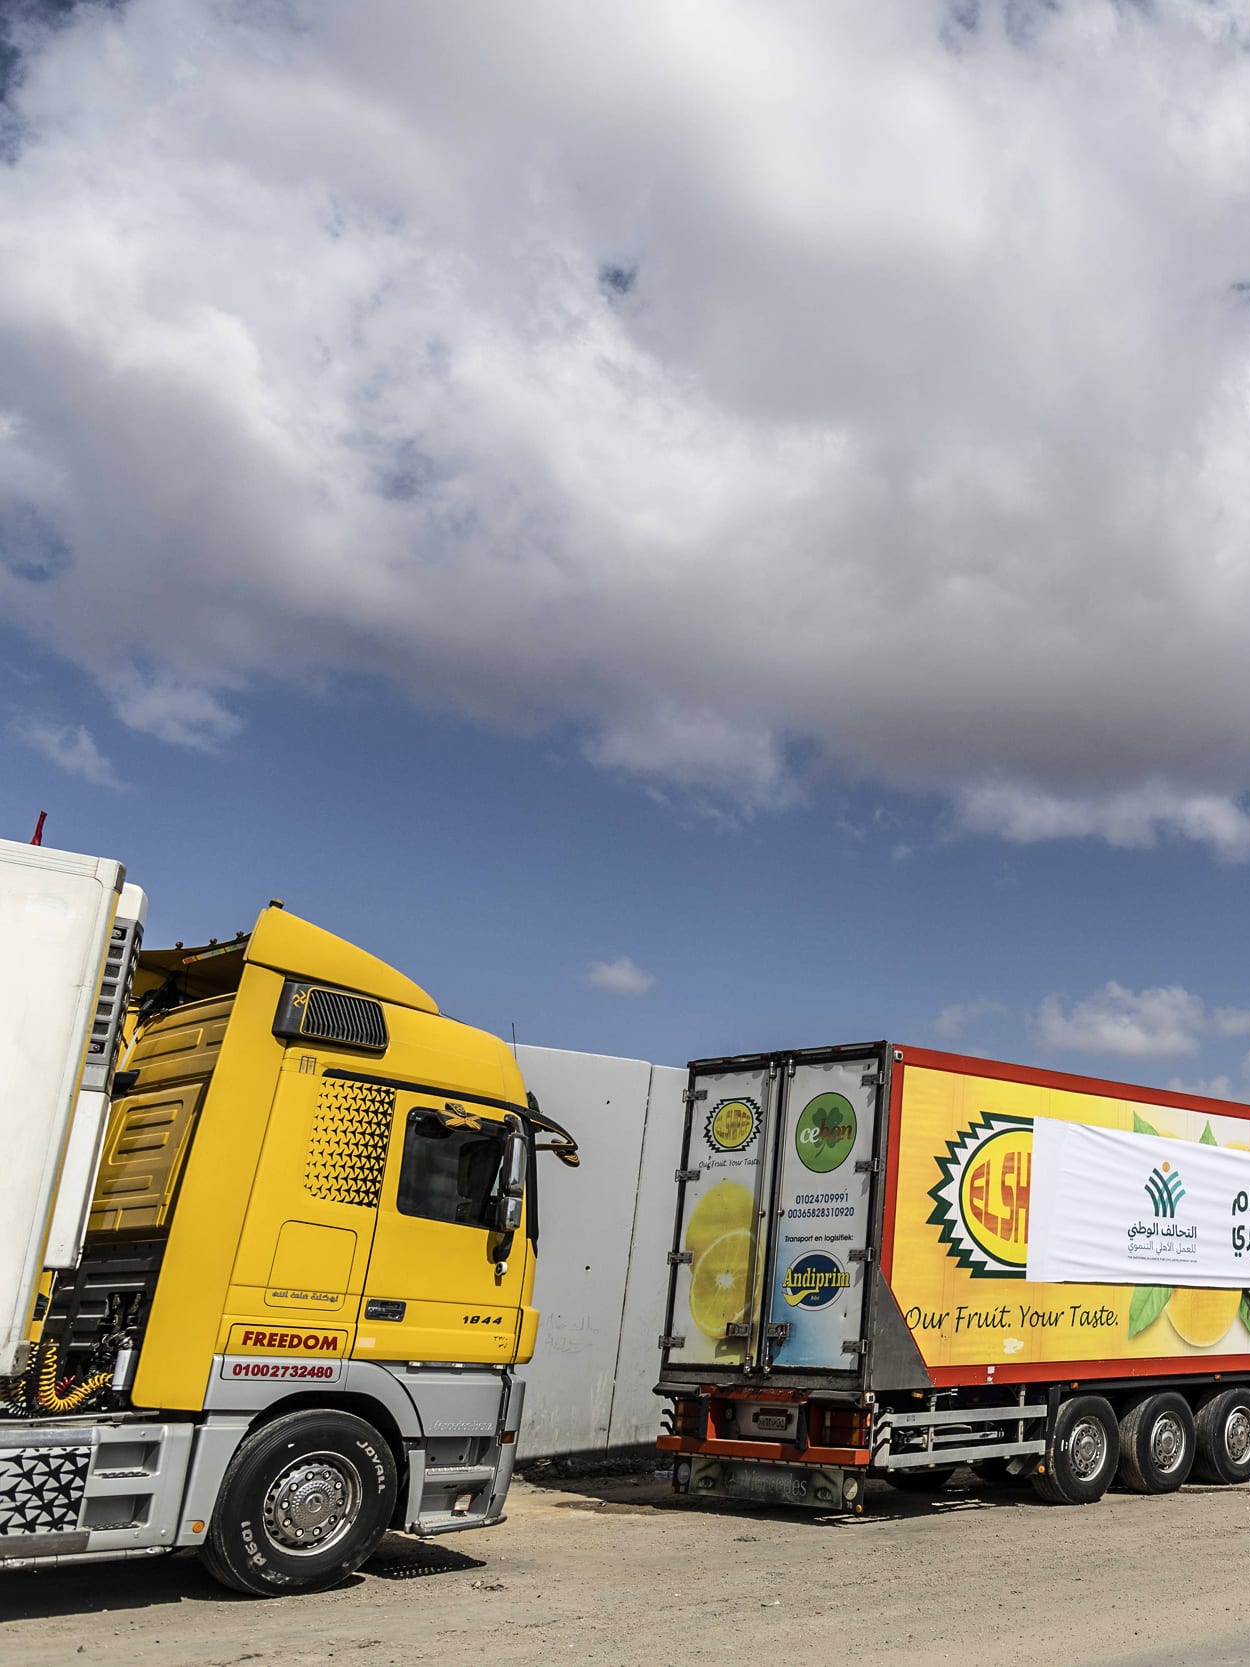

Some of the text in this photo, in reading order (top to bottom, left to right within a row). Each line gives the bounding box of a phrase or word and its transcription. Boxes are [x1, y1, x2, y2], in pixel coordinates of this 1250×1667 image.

[795, 1193, 849, 1205] 01024709991
[969, 1151, 1031, 1244] ELSH
[788, 1206, 855, 1219] 00365828310920
[1127, 1221, 1197, 1241] التحالف الوطني
[785, 1234, 813, 1244] Transport
[1127, 1240, 1154, 1254] التنموي
[1176, 1242, 1197, 1255] للعمل
[782, 1266, 850, 1293] Andiprim
[462, 1315, 503, 1325] 1844
[905, 1304, 1119, 1333] Our Fruit. Your Taste.
[241, 1330, 338, 1351] FREEDOM
[232, 1363, 333, 1379] 01002732480
